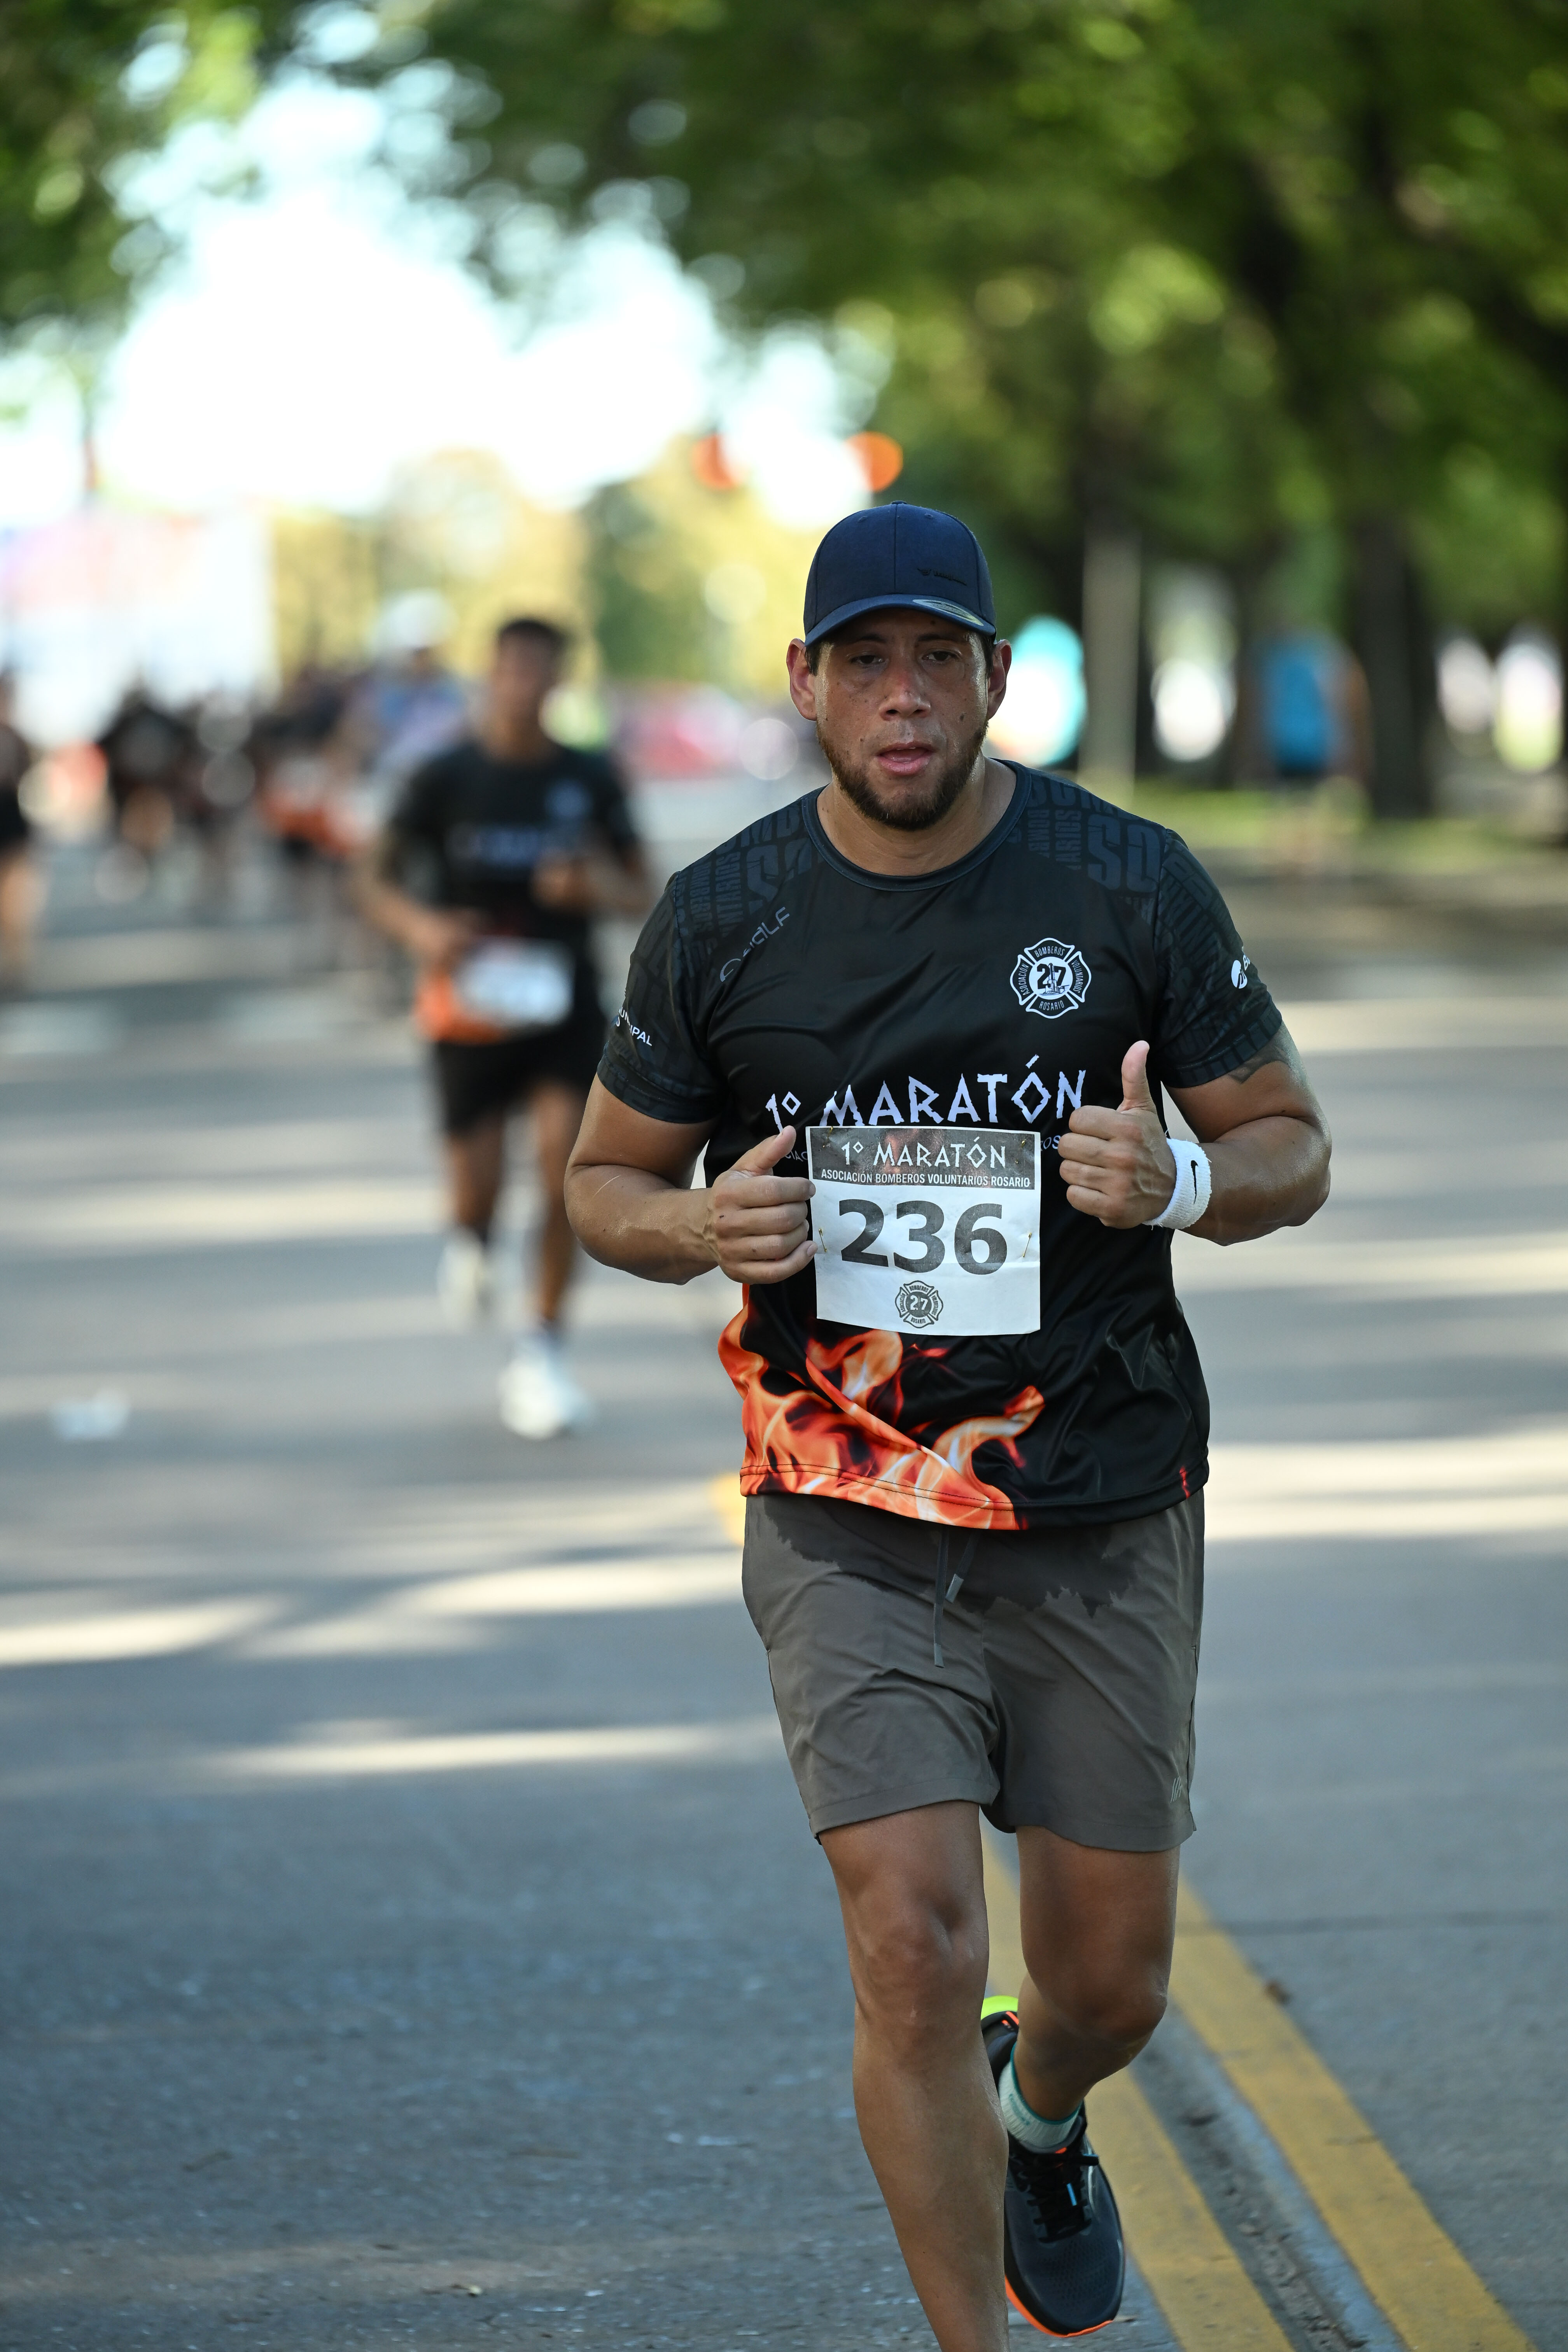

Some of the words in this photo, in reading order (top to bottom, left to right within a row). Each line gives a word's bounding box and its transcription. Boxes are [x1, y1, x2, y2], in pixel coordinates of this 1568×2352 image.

[1034, 946, 1065, 957] BOMBEROS
[1018, 963, 1030, 996] ASOCIACIÓN
[1037, 963, 1066, 989] 27
[1071, 960, 1083, 993] VOLUNTARIOS
[1039, 1000, 1064, 1010] ROSARIO
[820, 1054, 1086, 1127] MARATÓN
[873, 1136, 1006, 1168] MARATÓN
[821, 1169, 872, 1183] ASOCIACIÓN
[875, 1173, 925, 1183] BOMBEROS
[928, 1174, 988, 1186] VOLUNTARIOS
[991, 1176, 1030, 1187] ROSARIO
[839, 1199, 1007, 1275] 236
[910, 1295, 928, 1310] 27
